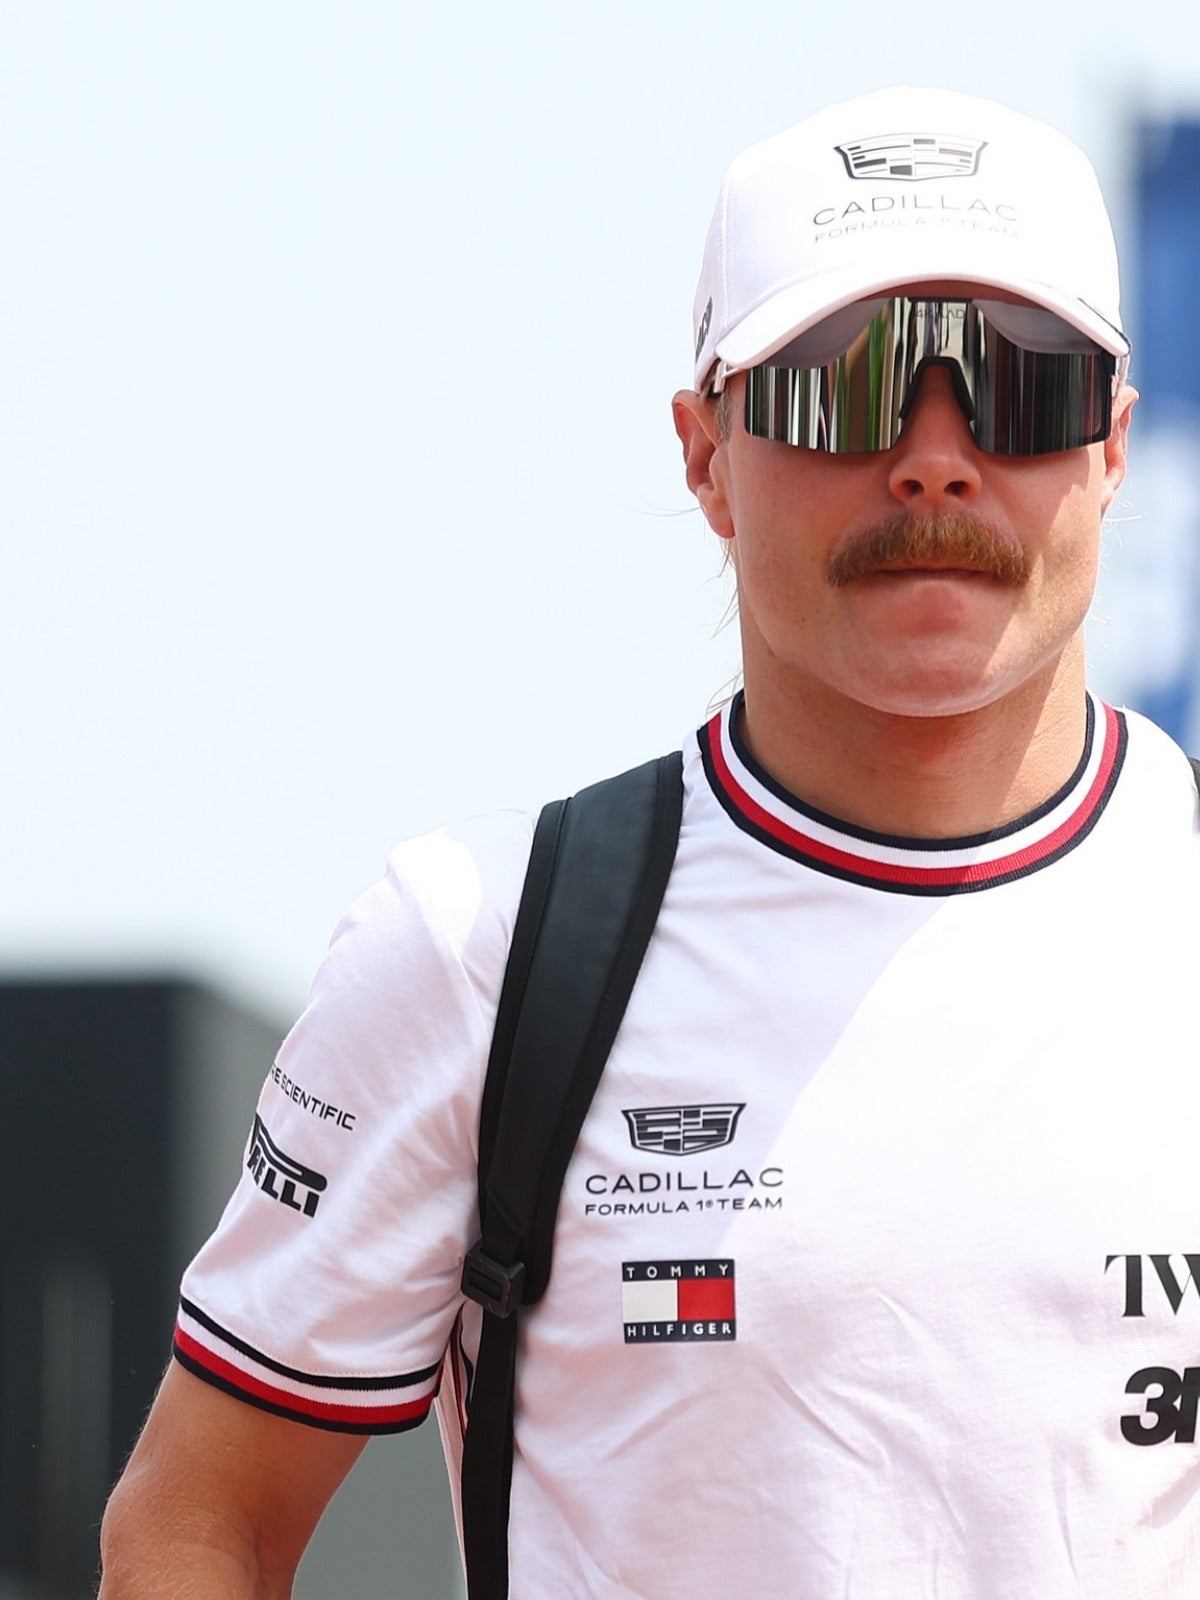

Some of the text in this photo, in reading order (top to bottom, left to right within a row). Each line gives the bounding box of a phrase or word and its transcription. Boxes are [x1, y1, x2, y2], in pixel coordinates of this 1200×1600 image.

[813, 195, 1017, 226] CADILLAC
[281, 1073, 356, 1131] SCIENTIFIC
[585, 1167, 784, 1195] CADILLAC
[585, 1201, 690, 1216] FORMULA
[717, 1197, 783, 1211] TEAM
[626, 1264, 728, 1279] TOMMY
[626, 1322, 732, 1337] HILFIGER
